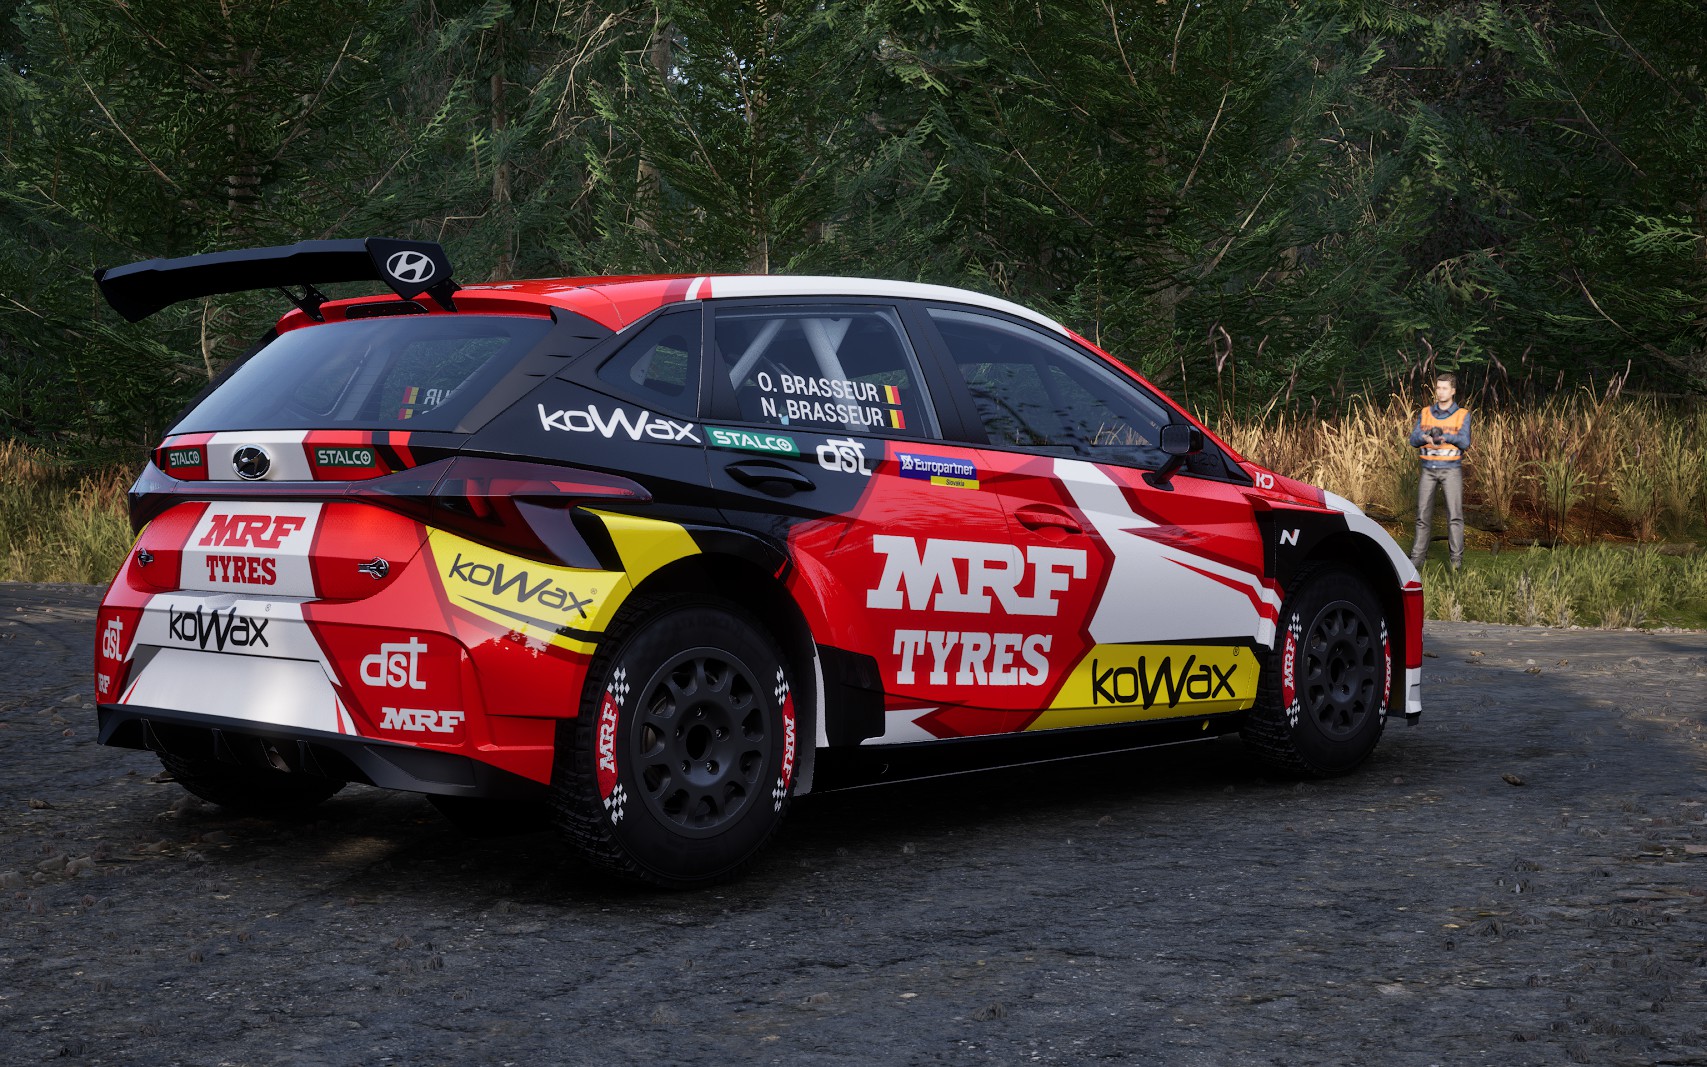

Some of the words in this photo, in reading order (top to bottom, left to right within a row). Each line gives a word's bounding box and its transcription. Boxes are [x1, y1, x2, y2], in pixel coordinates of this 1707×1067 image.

[757, 371, 778, 393] O.
[781, 374, 880, 402] BRASSEUR
[760, 397, 782, 418] N.
[786, 400, 885, 427] BRASSEUR
[712, 430, 793, 452] STALCO
[169, 452, 200, 467] STALCO
[318, 450, 372, 465] STALCO
[913, 458, 974, 475] Europartner
[945, 479, 965, 487] Slovakia
[198, 514, 306, 548] MRF
[206, 555, 276, 585] TYRES
[866, 534, 1087, 617] MRF
[893, 629, 1052, 686] TYRES
[1284, 638, 1295, 690] MRF
[98, 672, 110, 695] RF
[380, 708, 464, 733] MRF
[600, 703, 618, 774] MRF
[783, 715, 796, 779] MRF
